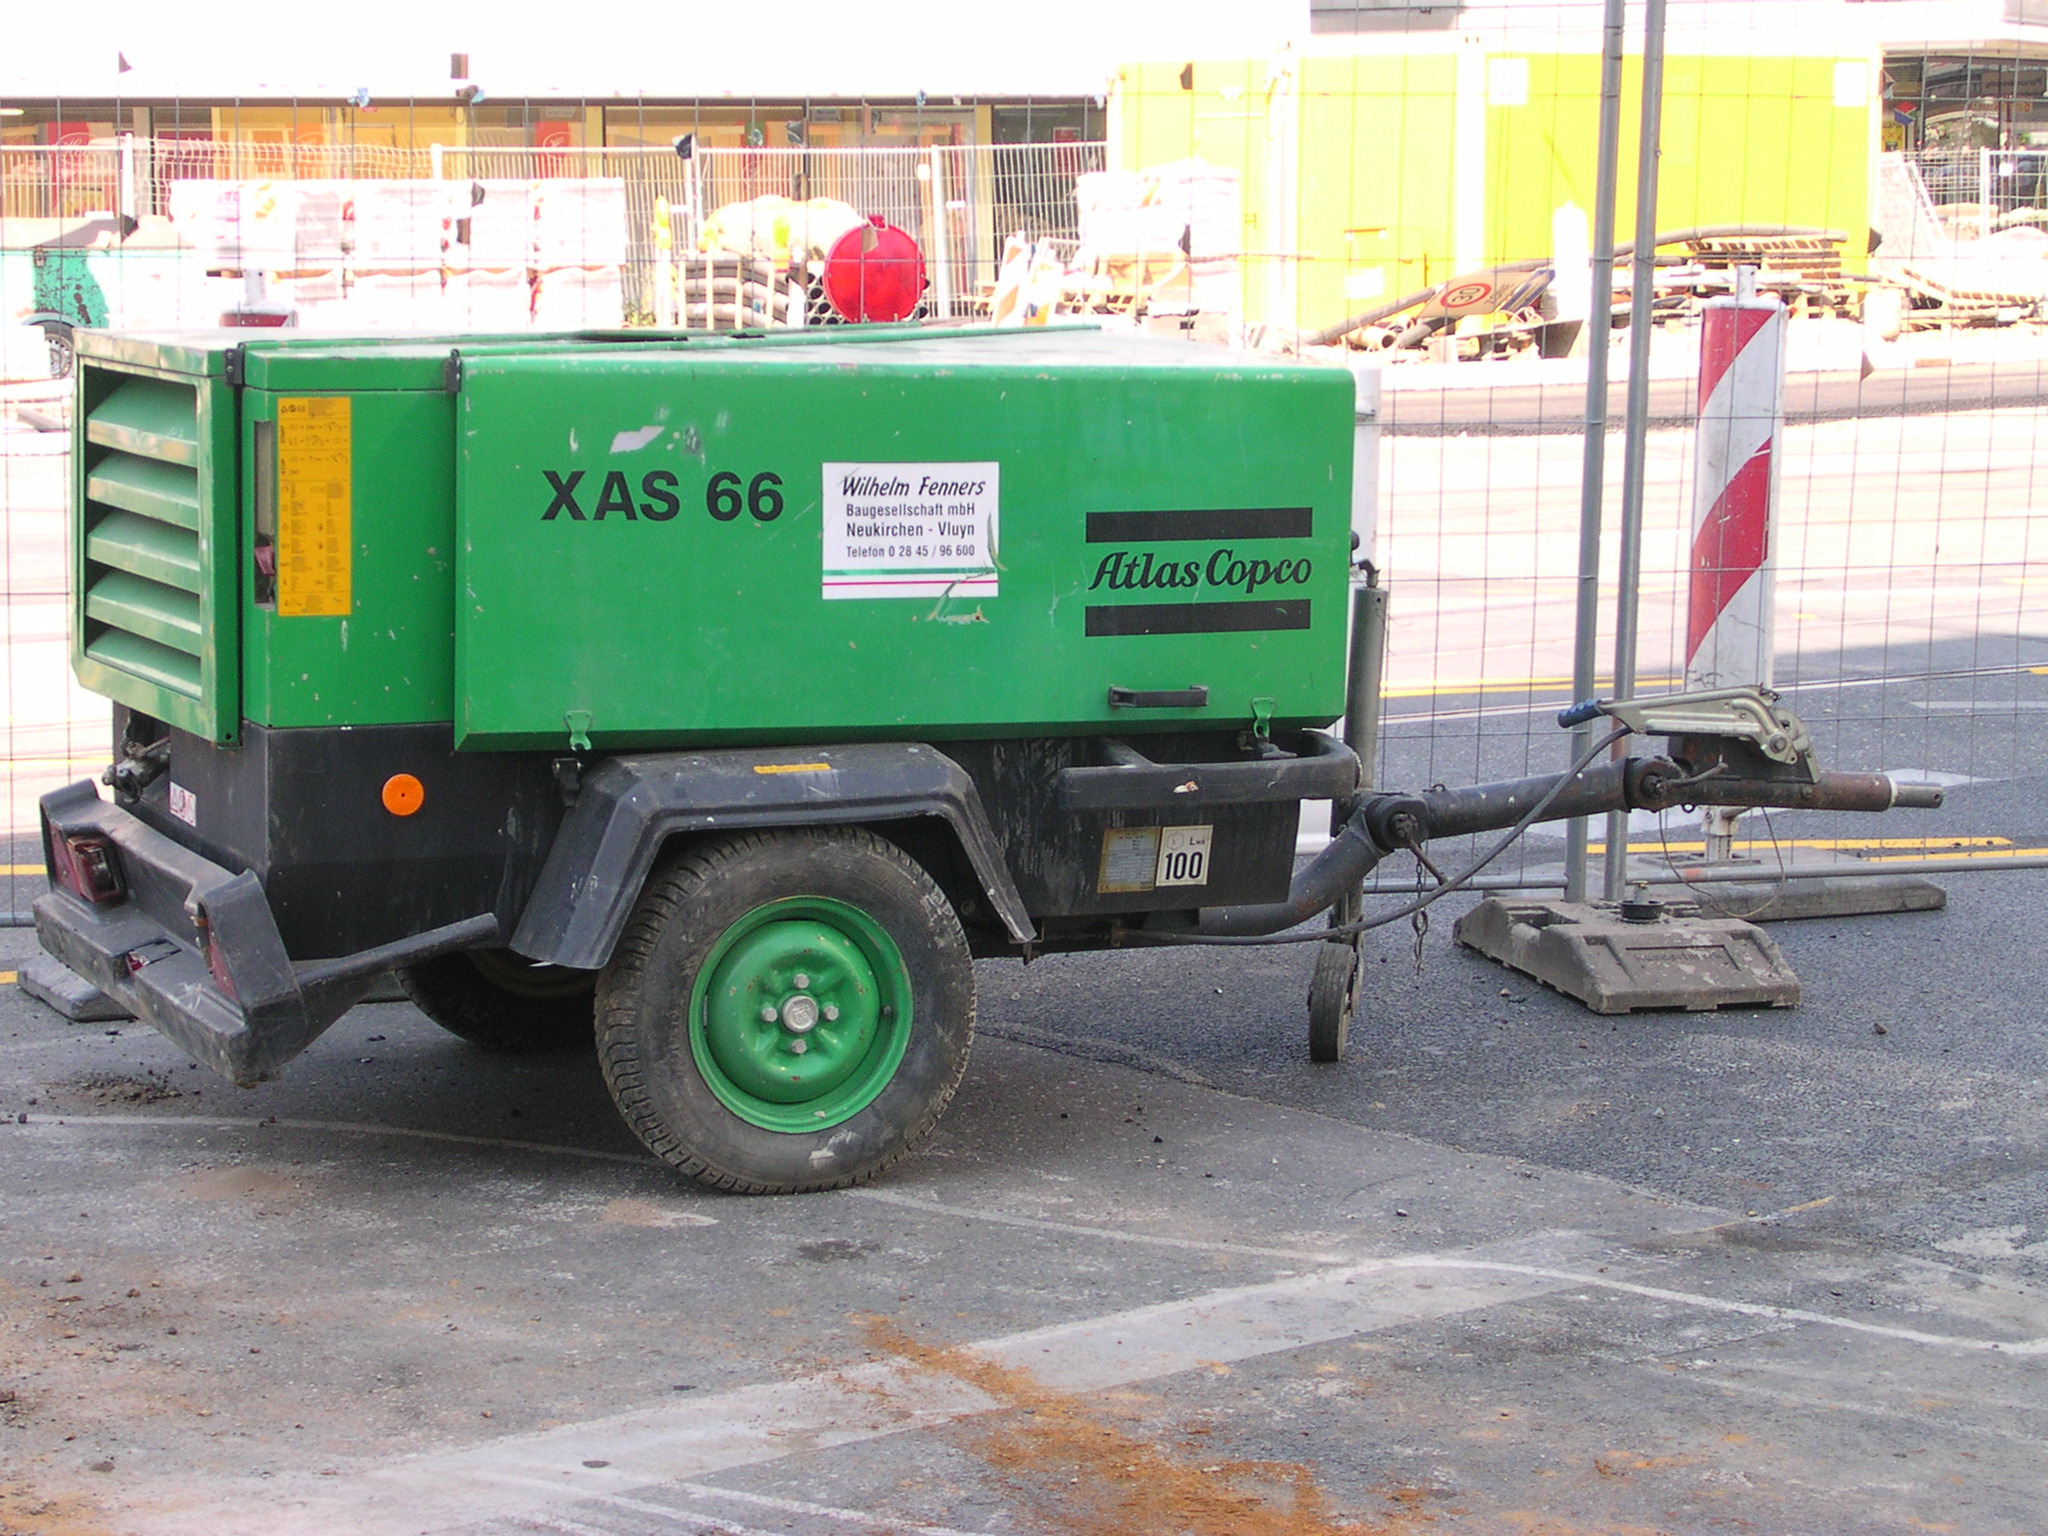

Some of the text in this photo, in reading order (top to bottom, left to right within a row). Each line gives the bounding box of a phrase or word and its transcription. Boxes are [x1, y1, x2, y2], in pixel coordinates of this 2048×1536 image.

[1452, 287, 1481, 302] 30
[540, 469, 784, 522] XAS 66
[842, 476, 986, 497] Wilhelm Fenners
[846, 502, 975, 519] Baugesellschaft mbH
[846, 522, 923, 537] Neukirchen
[938, 521, 975, 539] Vluyn
[846, 546, 885, 558] Telefon
[888, 545, 895, 557] 0
[898, 545, 912, 557] 28
[915, 545, 929, 557] 45
[939, 544, 952, 557] 96
[955, 544, 975, 556] 600
[1087, 549, 1312, 594] Atlas Copco
[1165, 851, 1203, 880] 100
